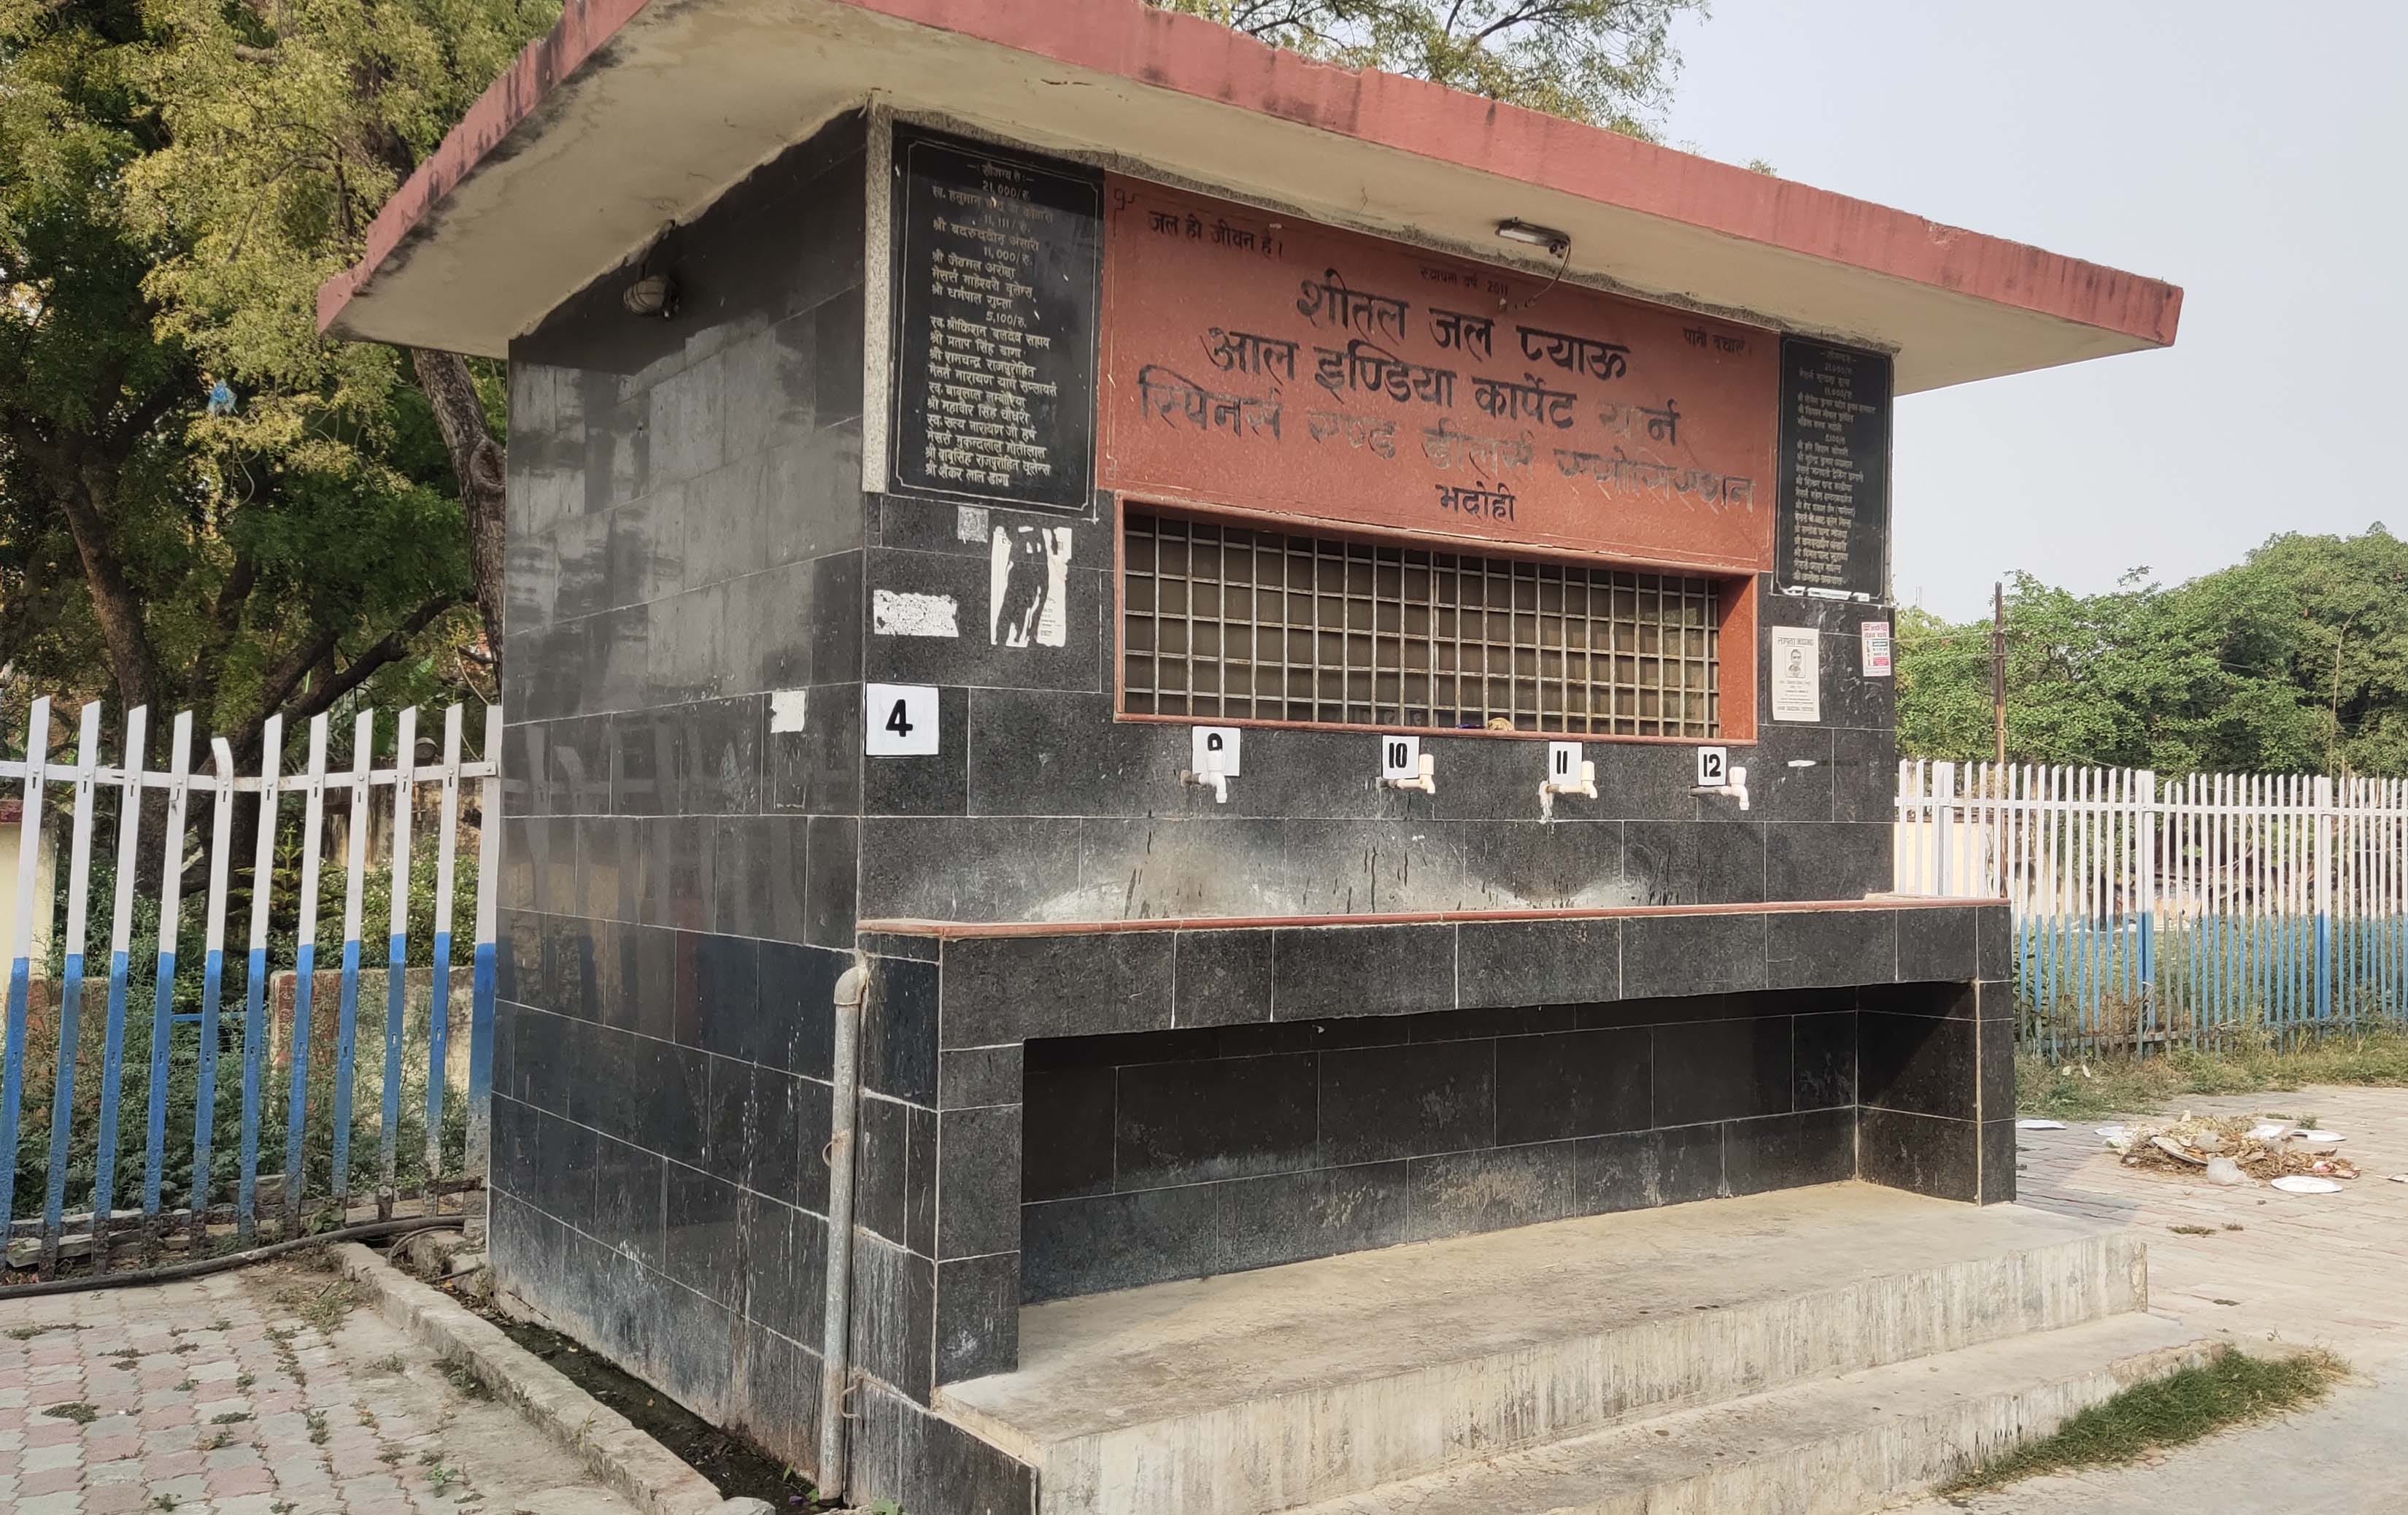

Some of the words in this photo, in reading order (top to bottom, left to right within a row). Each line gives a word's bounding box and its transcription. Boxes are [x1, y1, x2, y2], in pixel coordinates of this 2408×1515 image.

[933, 217, 946, 232] श्री
[1149, 210, 1179, 235] जल
[1185, 213, 1203, 240] ही
[1209, 219, 1257, 251] जीवन
[933, 248, 944, 263] श्री
[932, 282, 943, 296] श्री
[947, 286, 982, 304] धर्मपाल
[987, 295, 1013, 309] गुप्ता
[1297, 268, 1409, 345] शीतल
[1428, 307, 1494, 362] जल
[1516, 325, 1631, 381] प्याऊ
[1683, 326, 1707, 348] पानी
[930, 330, 943, 346] श्री
[975, 338, 995, 357] सिंह
[930, 346, 943, 361] श्री
[986, 358, 1036, 378] राजपुरोहित
[1200, 326, 1300, 385] आल
[1313, 339, 1457, 408] इण्डिया
[955, 369, 995, 385] नारायण
[927, 395, 939, 411] श्री
[941, 398, 974, 417] महावीर
[978, 404, 997, 419] सिंह
[1000, 406, 1030, 425] चौधरी
[1137, 365, 1284, 442] स्पिनर्स
[944, 417, 965, 430] सत्य
[970, 421, 1004, 436] नारायण
[1005, 423, 1018, 439] जी
[925, 442, 936, 460] श्री
[976, 453, 1020, 472] राजपुरोहित
[1006, 440, 1047, 459] मोतीलाल
[925, 459, 937, 477] श्री
[966, 469, 986, 484] लाल
[1435, 482, 1516, 521] भदोही
[886, 698, 914, 737] 4
[1389, 742, 1408, 768] 10
[1556, 749, 1567, 774] 11
[1703, 753, 1721, 777] 12
